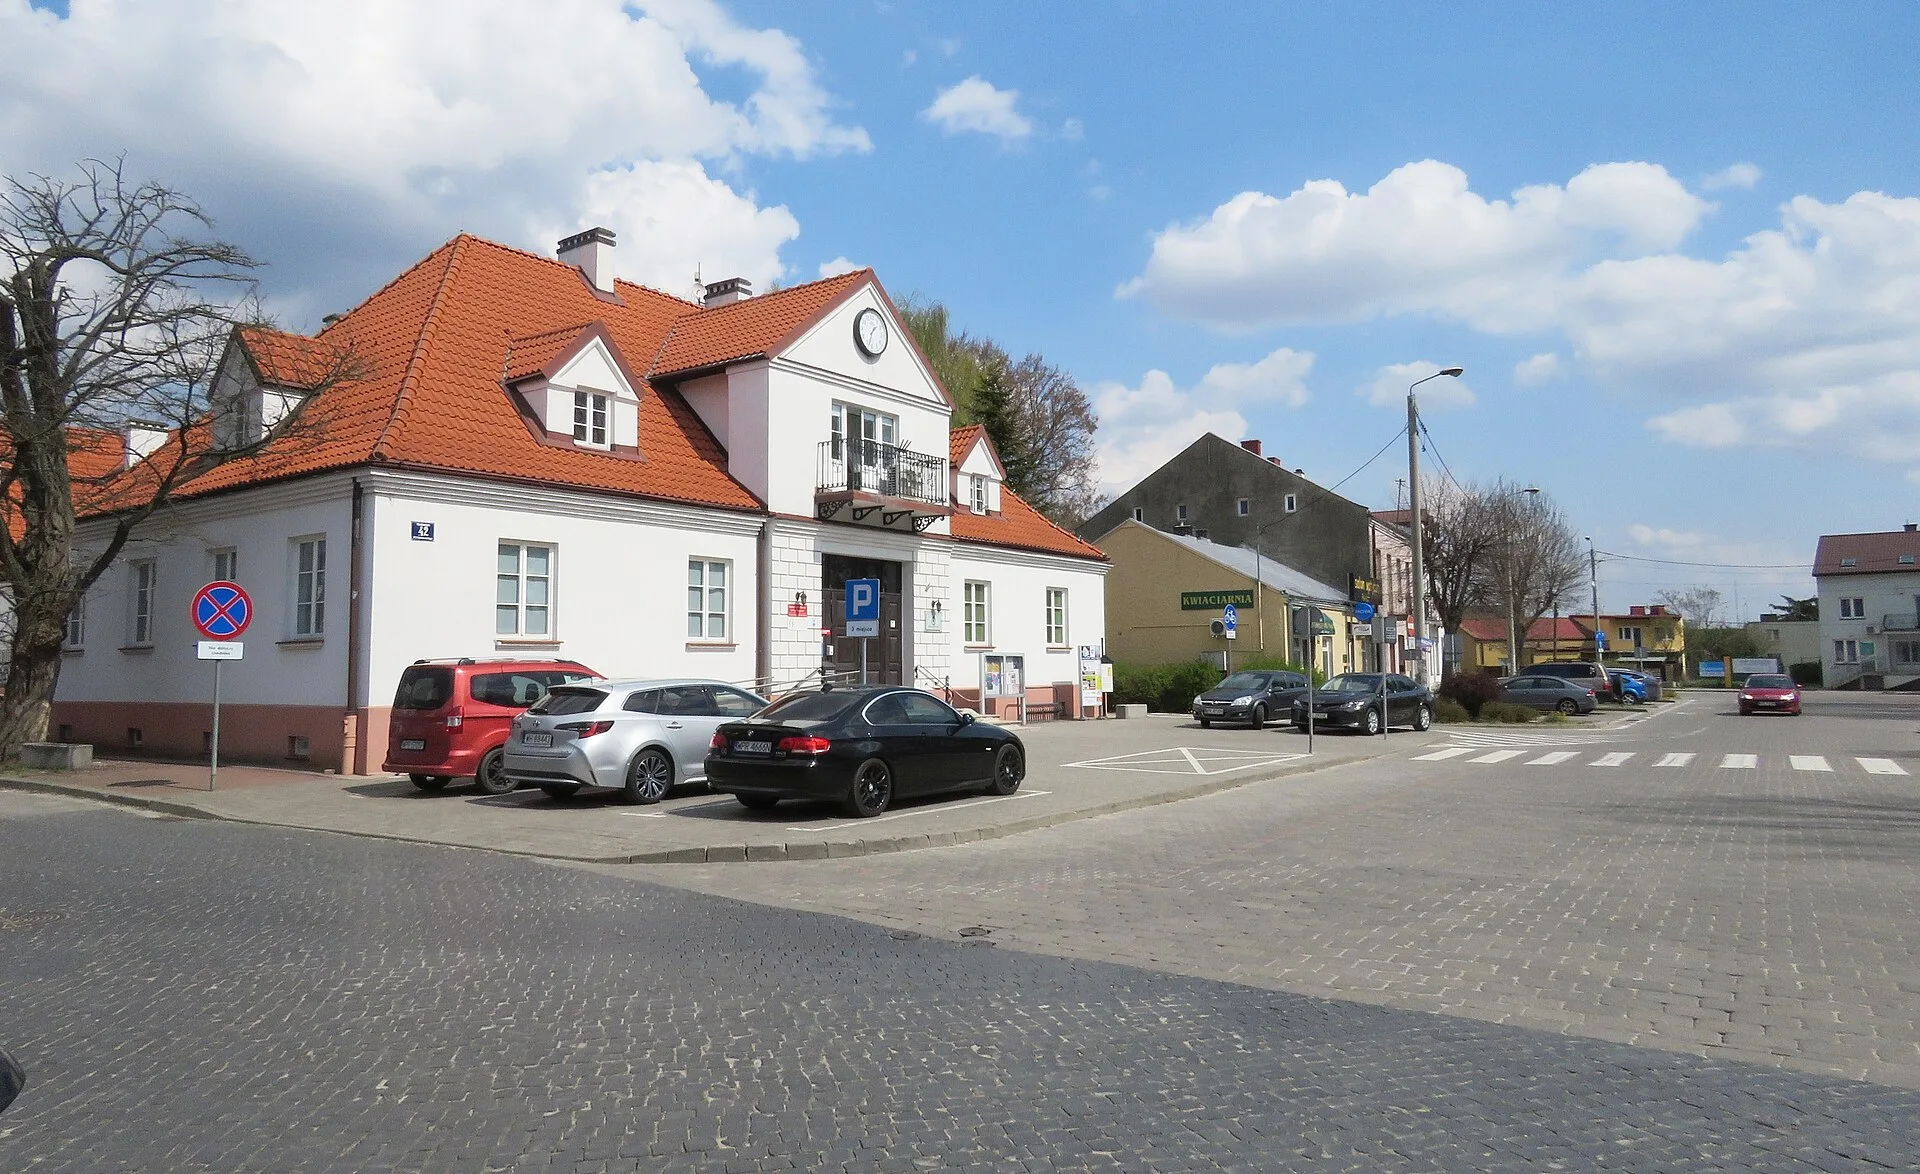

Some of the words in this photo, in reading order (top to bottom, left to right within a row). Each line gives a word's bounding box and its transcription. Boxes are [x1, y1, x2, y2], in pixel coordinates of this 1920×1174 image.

[417, 526, 430, 537] 42
[852, 584, 872, 616] P
[1183, 594, 1252, 606] KWIACIARNIA
